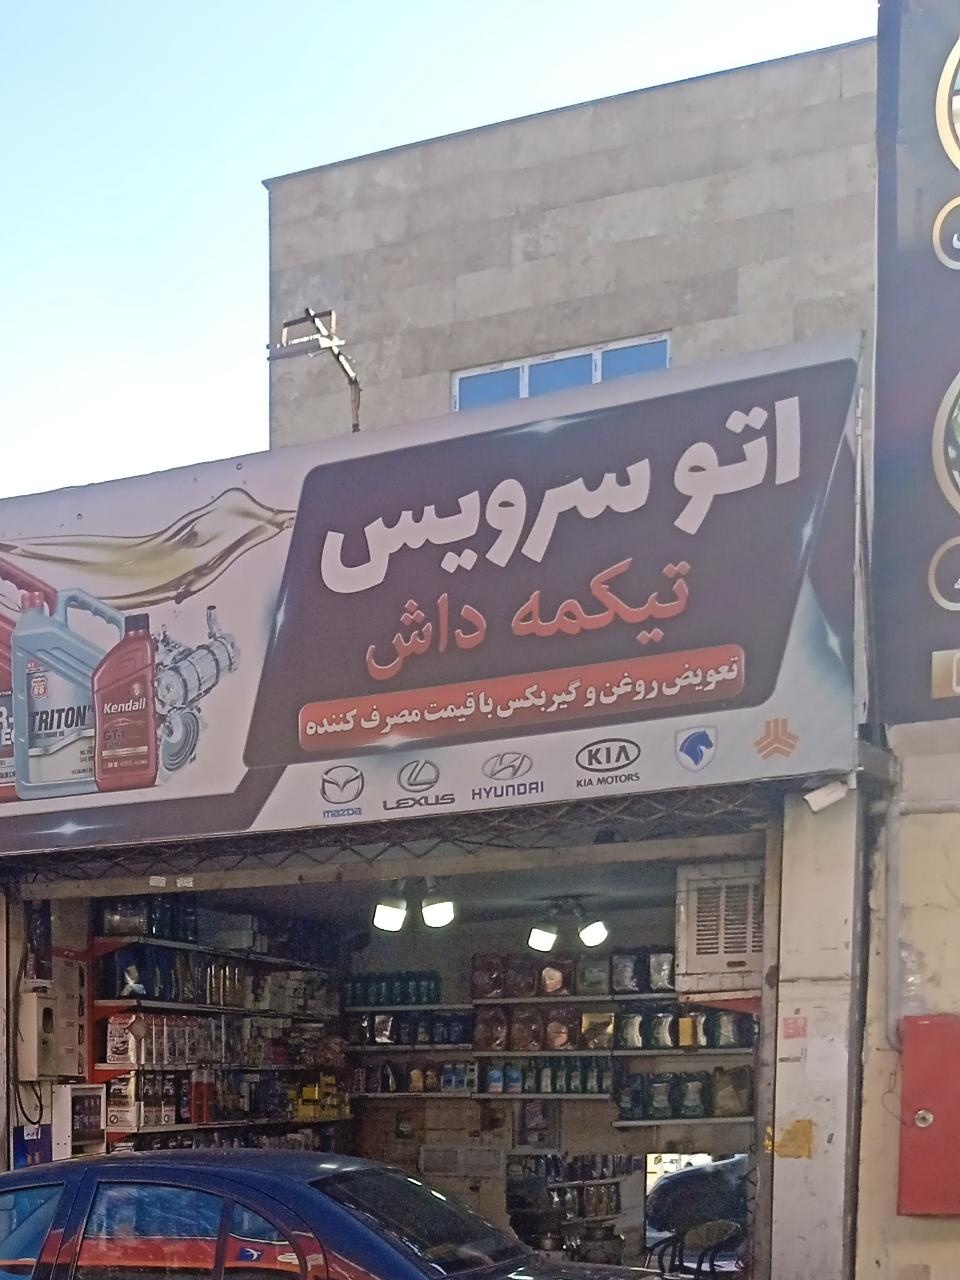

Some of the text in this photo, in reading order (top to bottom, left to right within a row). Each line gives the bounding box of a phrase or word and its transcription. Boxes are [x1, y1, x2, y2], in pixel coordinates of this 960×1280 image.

[320, 396, 801, 594] اتو سرویس
[365, 557, 692, 680] تیکمه داش
[103, 698, 146, 714] Kendall
[305, 656, 738, 736] تعویض روغن و گیربکس با قیمت مصرف کننده
[31, 705, 87, 732] TRITON
[587, 744, 631, 766] KIA
[471, 780, 544, 800] HYUNDAI
[576, 772, 640, 788] KIA MOTORS
[383, 794, 456, 811] LEXUS
